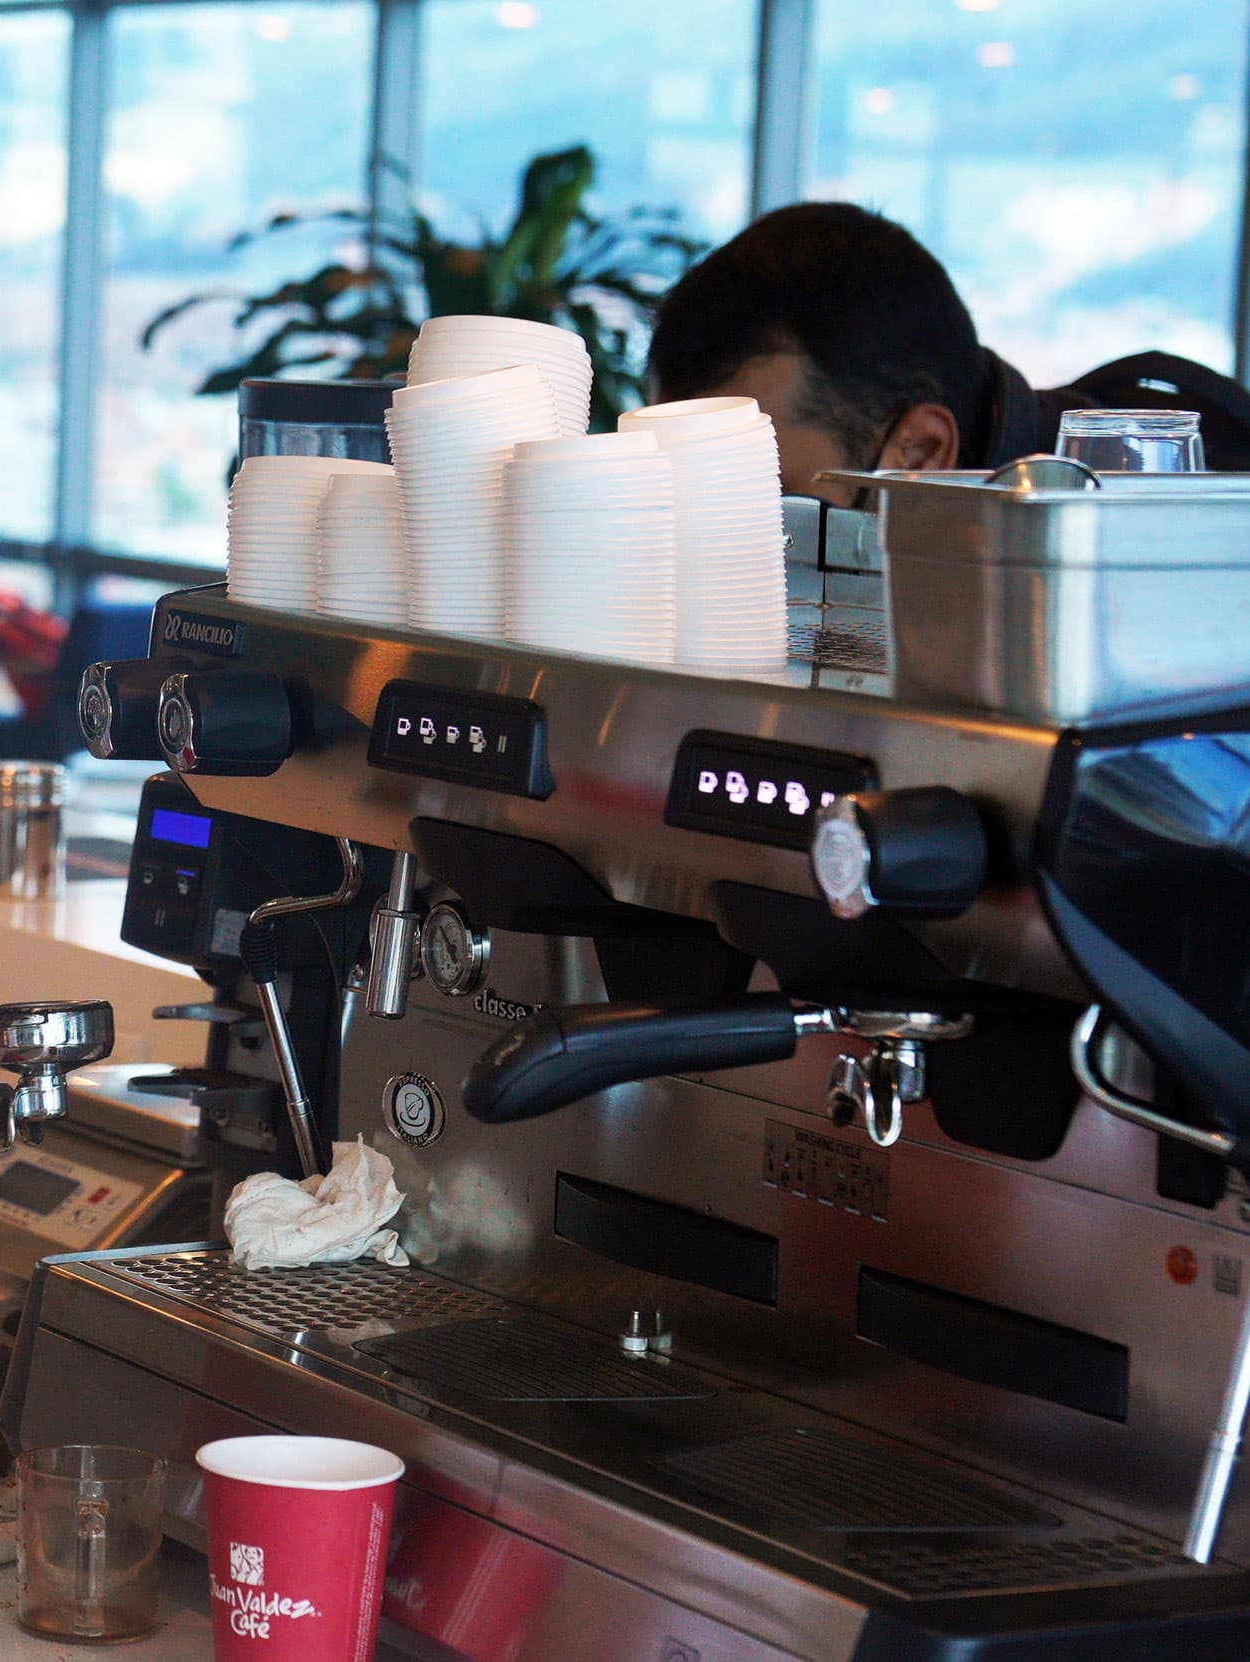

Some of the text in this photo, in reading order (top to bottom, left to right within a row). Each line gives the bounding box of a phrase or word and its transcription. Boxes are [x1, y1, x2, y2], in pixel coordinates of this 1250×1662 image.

[181, 621, 234, 646] RANCILIO
[473, 989, 527, 1022] classe
[236, 1586, 315, 1619] Valdez
[230, 1608, 270, 1640] Café
